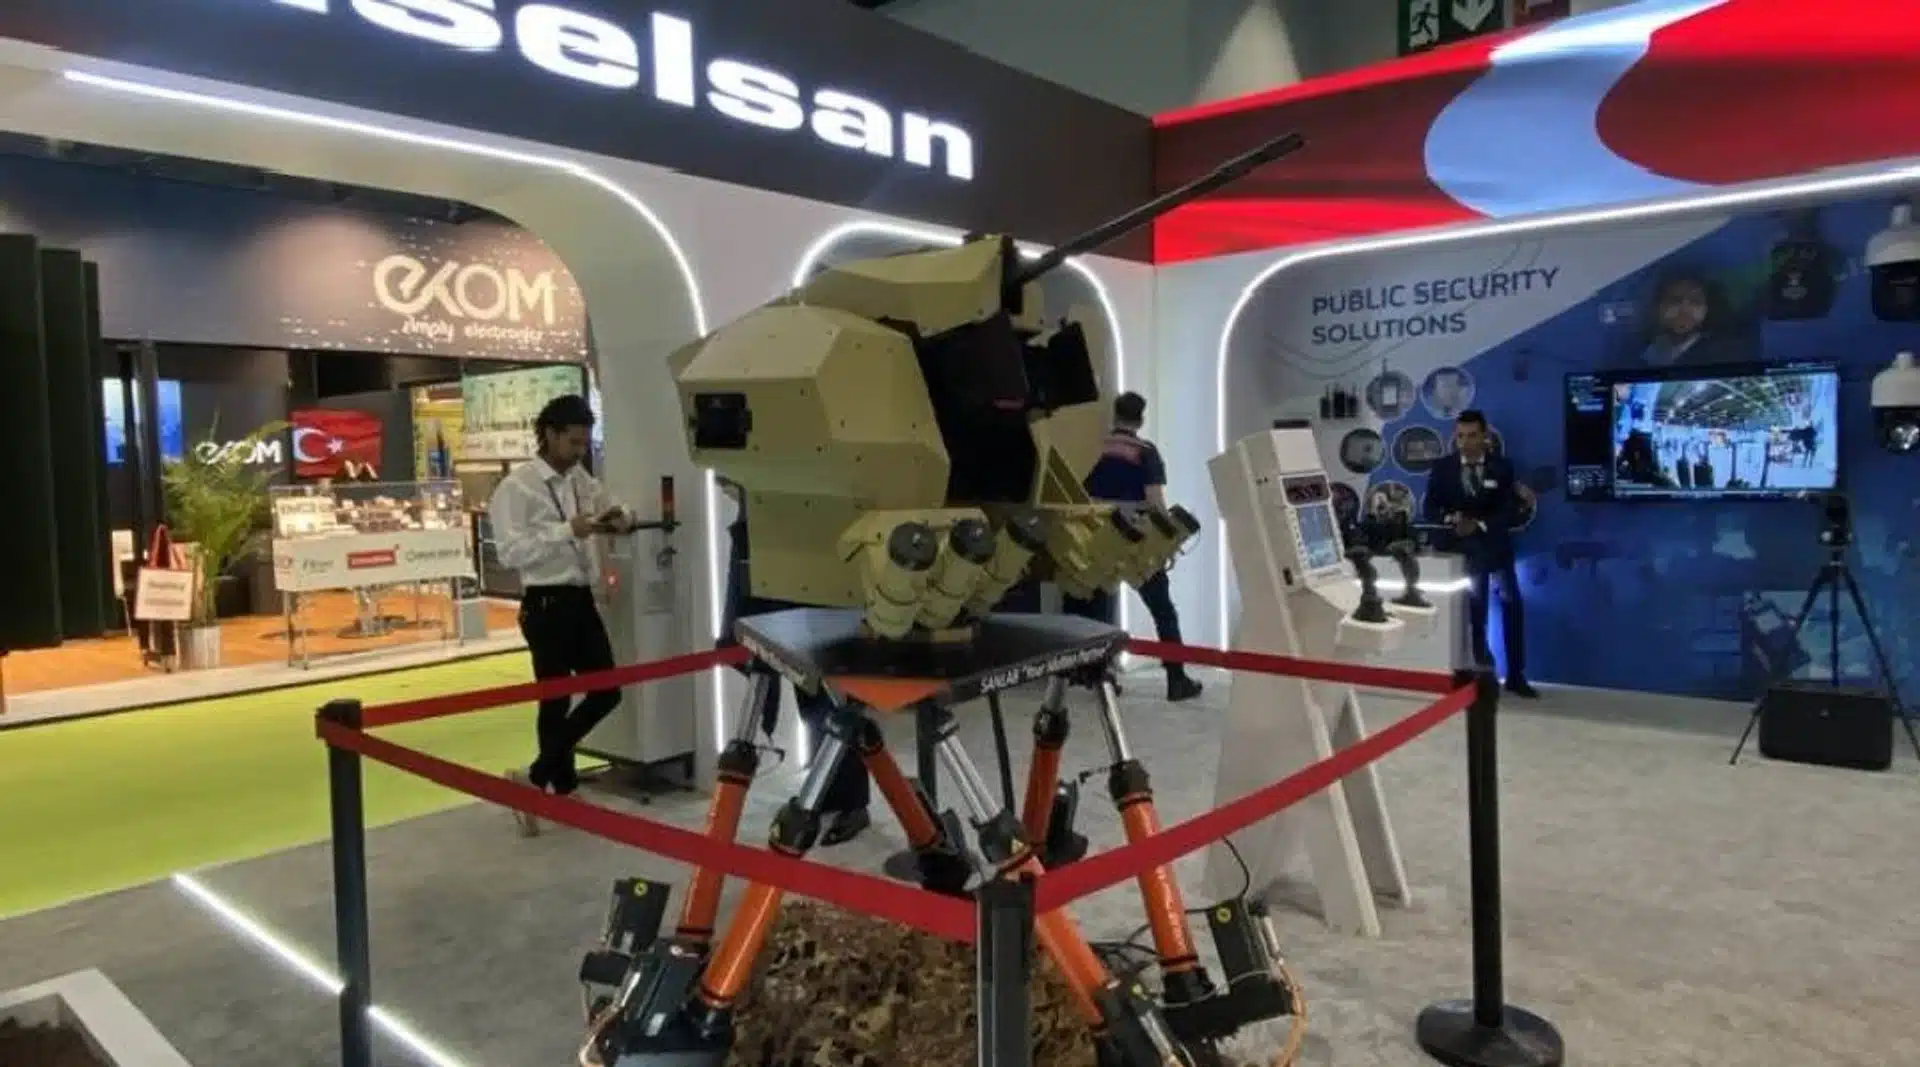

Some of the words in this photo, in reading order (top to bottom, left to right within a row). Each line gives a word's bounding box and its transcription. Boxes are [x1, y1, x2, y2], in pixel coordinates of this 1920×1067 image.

[270, 0, 974, 181] selsan
[1312, 284, 1404, 316] PUBLIC
[1412, 266, 1560, 305] SECURITY
[1311, 312, 1468, 345] SOLUTIONS
